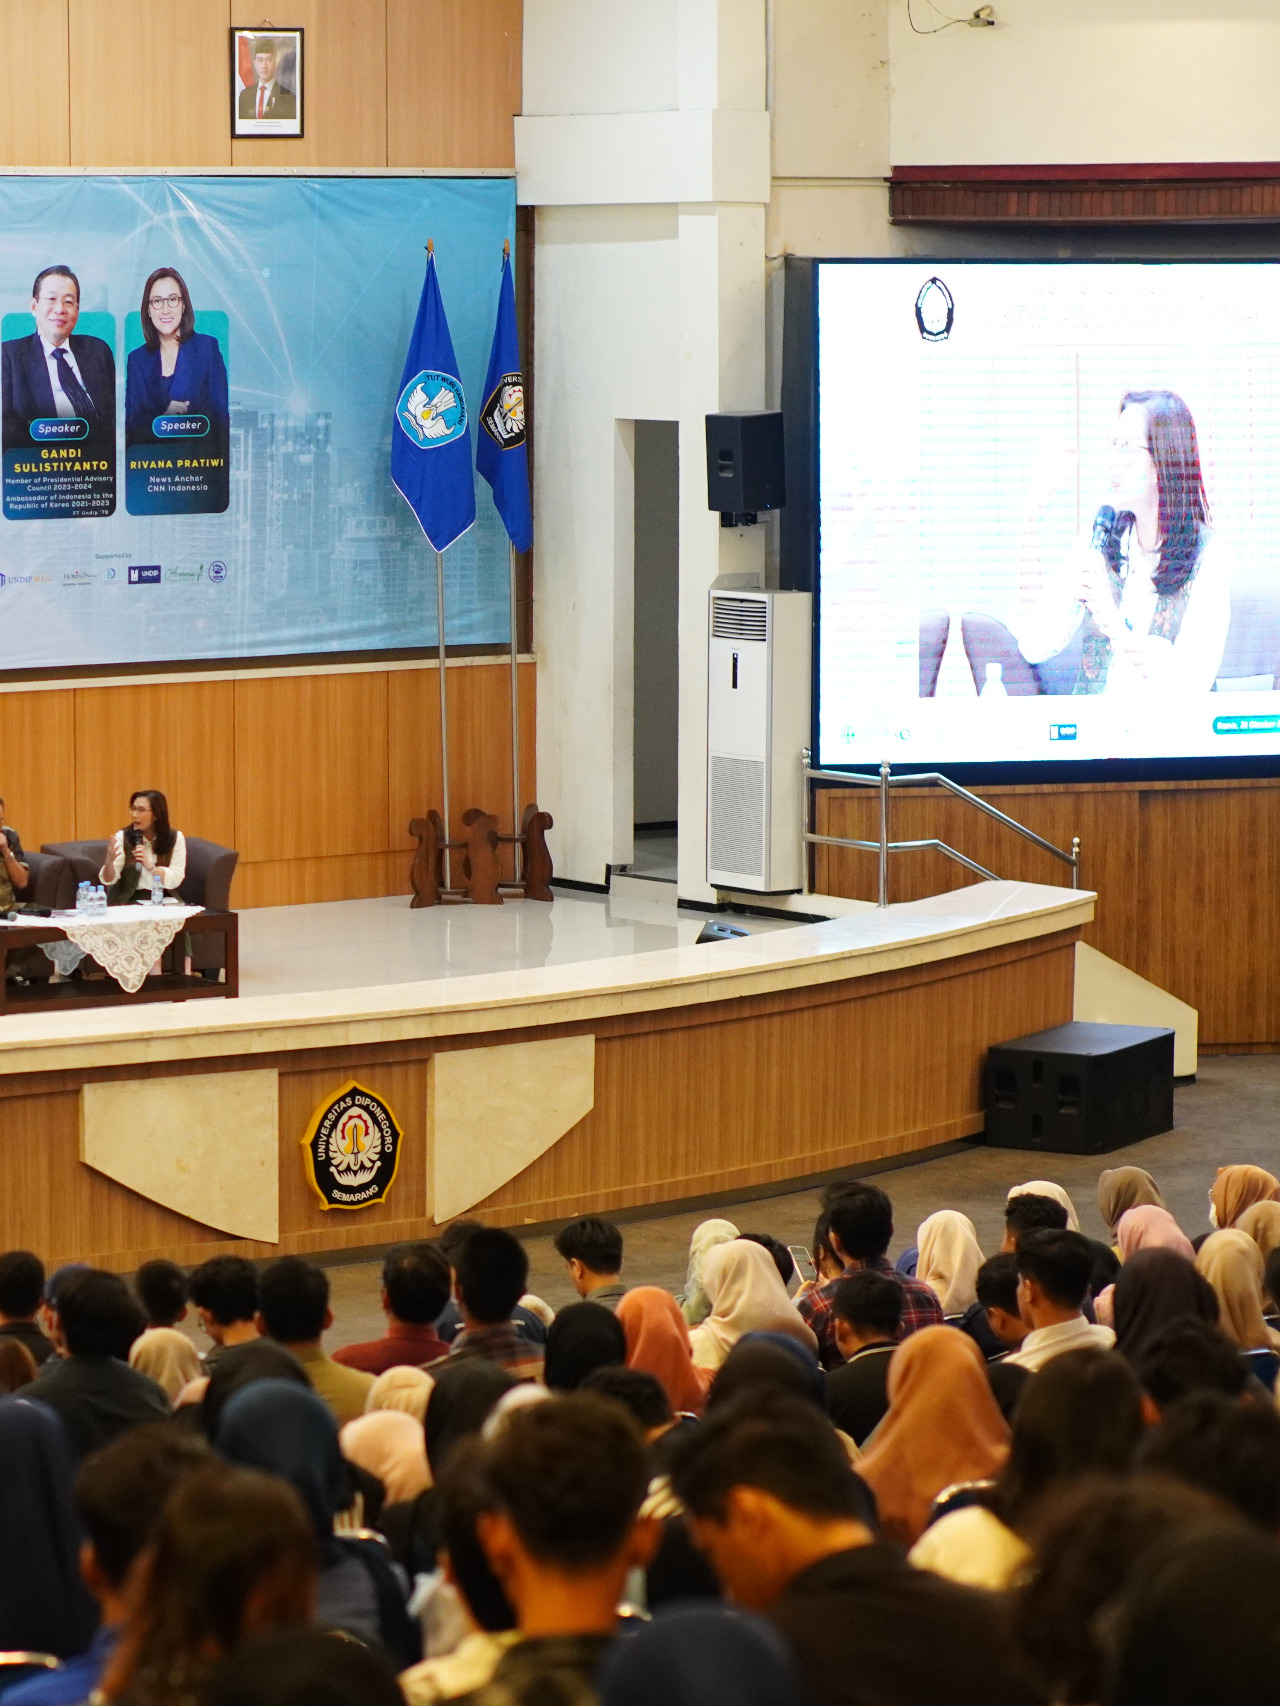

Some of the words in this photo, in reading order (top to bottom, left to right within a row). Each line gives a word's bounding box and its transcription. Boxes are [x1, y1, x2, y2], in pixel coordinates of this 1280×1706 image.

[441, 377, 456, 389] WURI
[38, 424, 80, 435] Speaker
[161, 420, 201, 432] Speaker
[41, 448, 81, 458] GANDI
[14, 460, 108, 472] SULISTIYANTO
[130, 460, 172, 469] RIVANA
[177, 458, 224, 468] PRATIWI
[318, 1097, 352, 1160] UNIVERSITAS
[355, 1096, 392, 1152] DIPONEGORO
[332, 1184, 378, 1201] SEMARANG
